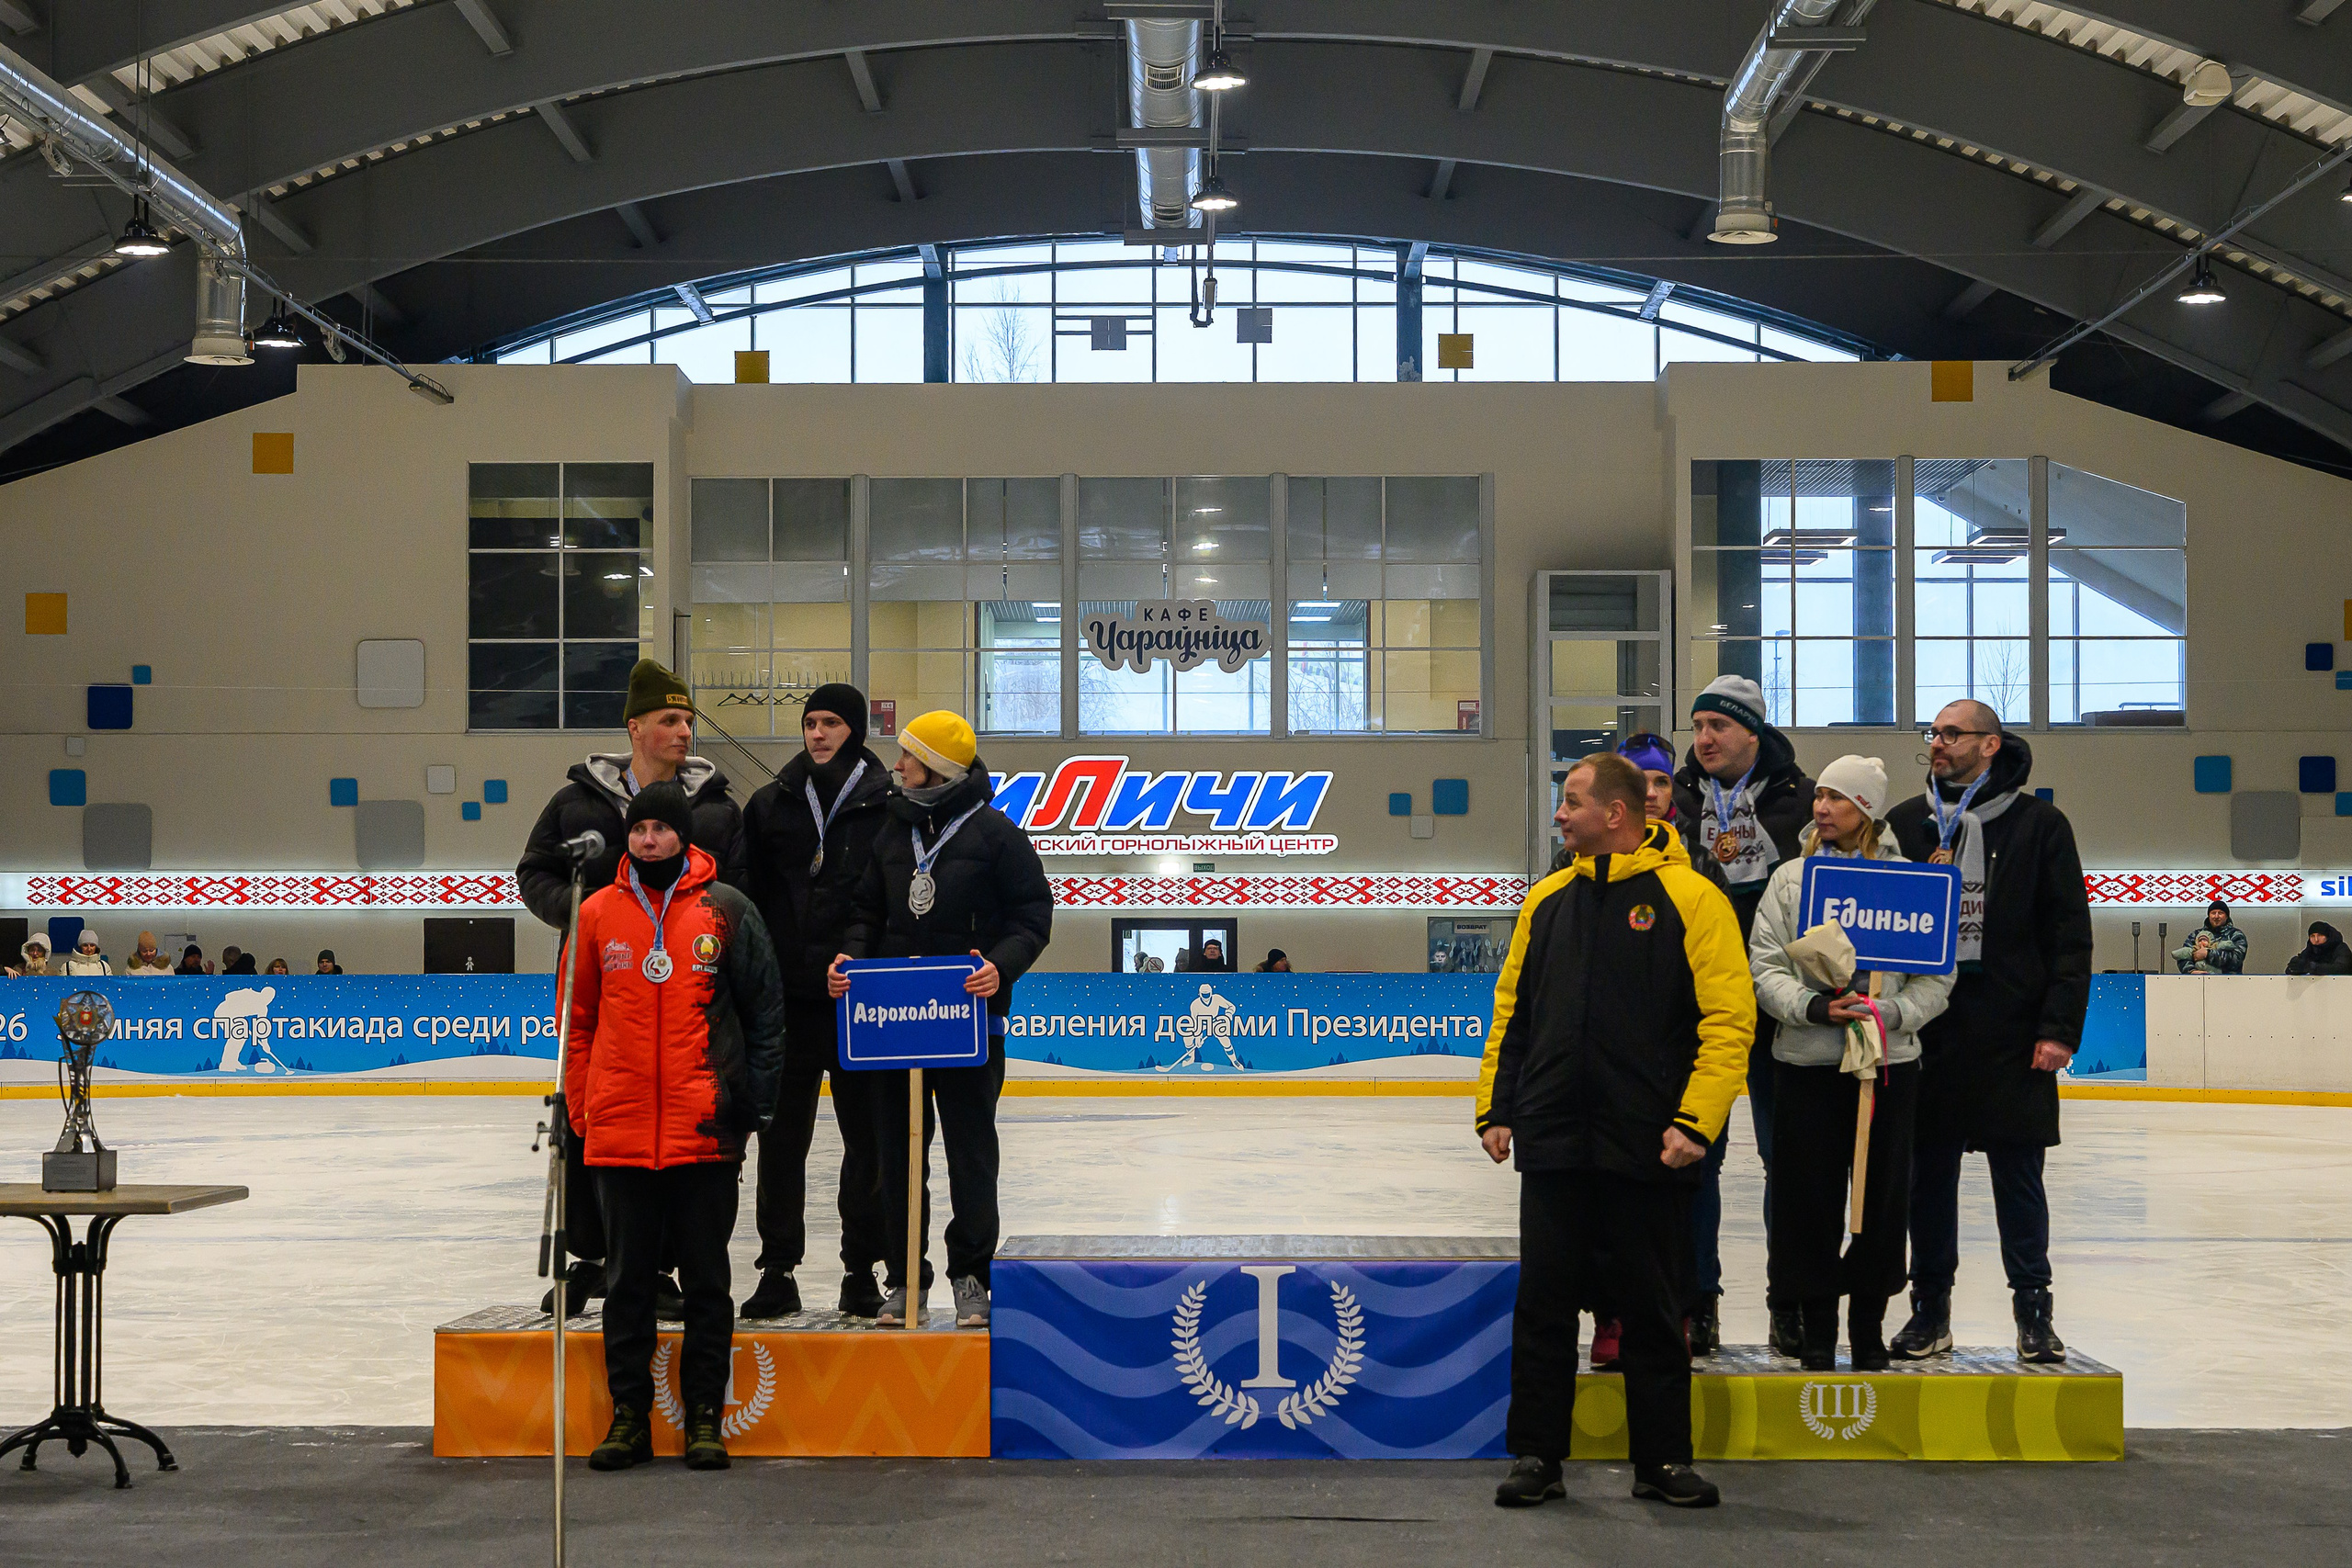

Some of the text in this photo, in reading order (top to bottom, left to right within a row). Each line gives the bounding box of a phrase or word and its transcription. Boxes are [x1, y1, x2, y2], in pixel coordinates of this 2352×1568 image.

[1144, 608, 1208, 622] КАФЕ
[1089, 621, 1263, 665] Чараўніца
[1101, 834, 1264, 851] ГОРНОЛЫЖНЫЙ
[1270, 839, 1335, 852] ЦЕНТР
[1823, 897, 1935, 934] Единые
[193, 1014, 403, 1045] спартакиада
[413, 1014, 511, 1045] среди
[1154, 1014, 1277, 1043] делами
[1287, 1008, 1483, 1044] Президента
[854, 998, 971, 1029] Агрохолдинг
[1240, 1266, 1296, 1388] I
[1813, 1384, 1864, 1418] III
